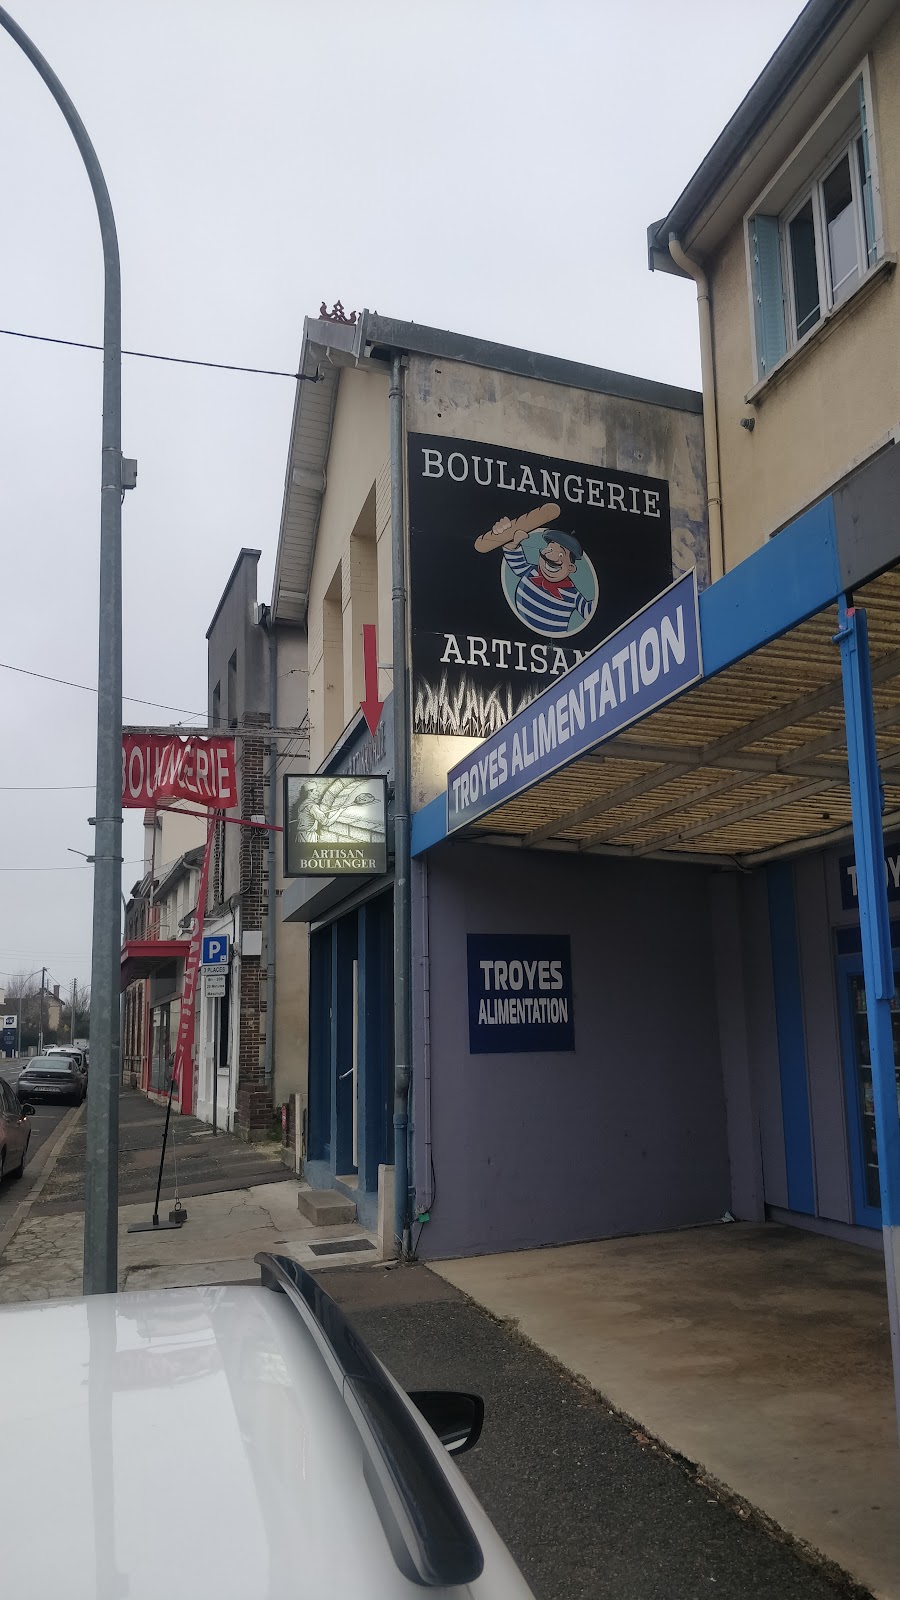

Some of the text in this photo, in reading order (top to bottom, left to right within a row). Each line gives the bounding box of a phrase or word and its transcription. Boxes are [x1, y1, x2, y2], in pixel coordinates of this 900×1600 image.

[421, 448, 661, 518] BOULANGERIE
[452, 740, 508, 814] TROYES
[510, 604, 686, 777] ALIMENTATION
[300, 859, 376, 869] BOULANGER
[311, 849, 364, 859] ARTISAN
[209, 941, 221, 959] P
[479, 960, 564, 991] TROYES
[478, 998, 569, 1025] ALIMENTATION
